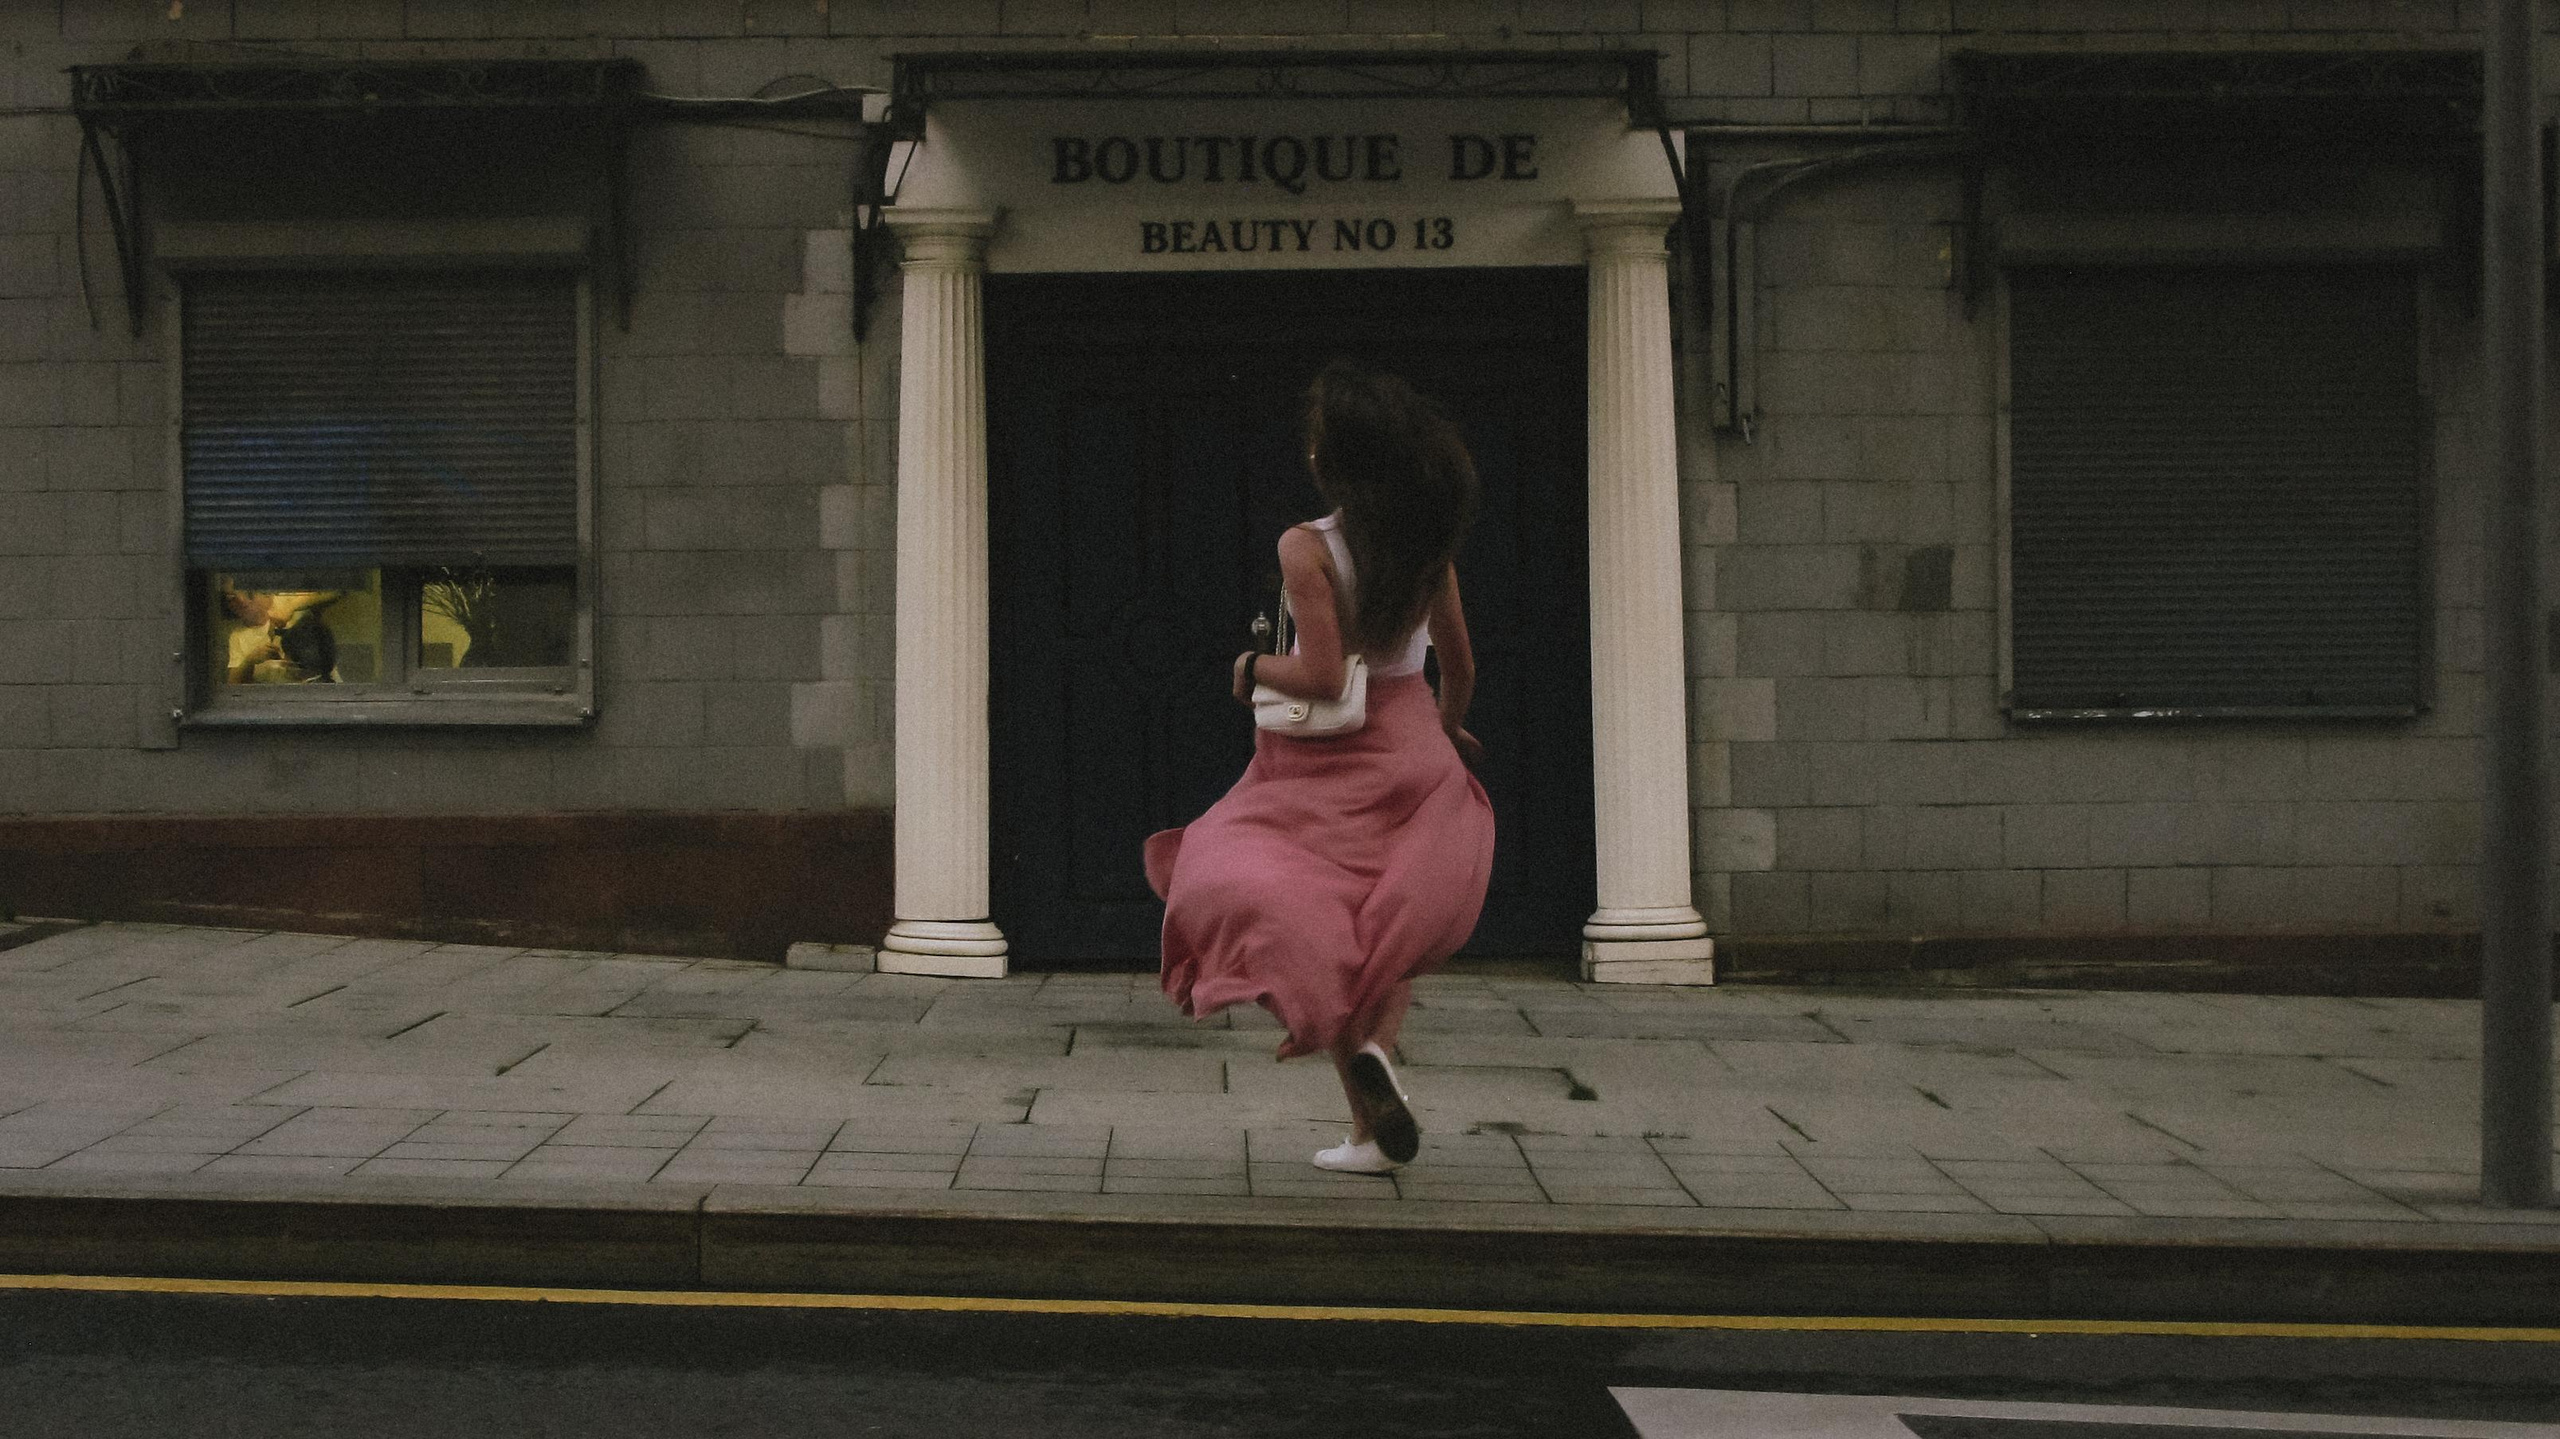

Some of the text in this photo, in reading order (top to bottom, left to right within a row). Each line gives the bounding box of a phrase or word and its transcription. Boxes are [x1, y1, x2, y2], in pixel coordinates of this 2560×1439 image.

[1051, 133, 1539, 194] BOUTIQUE DE
[1140, 217, 1455, 255] BEAUTY NO 13
